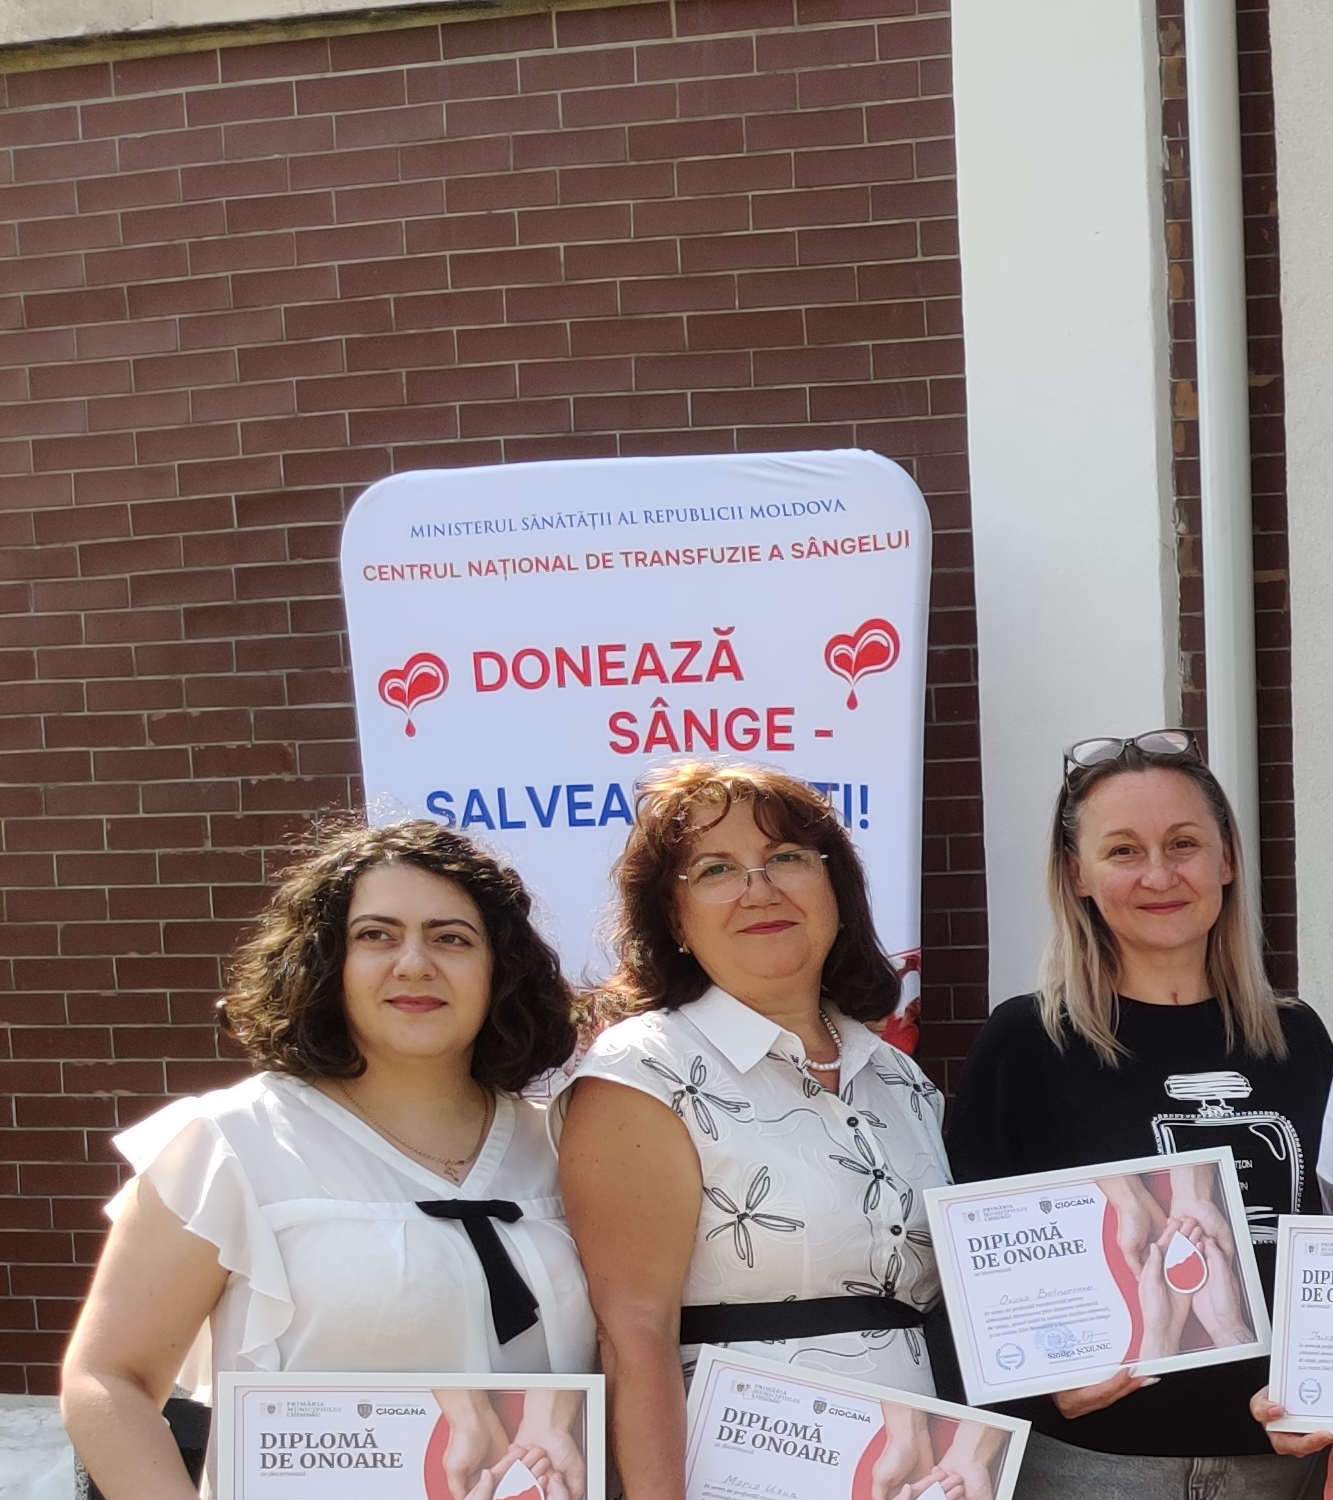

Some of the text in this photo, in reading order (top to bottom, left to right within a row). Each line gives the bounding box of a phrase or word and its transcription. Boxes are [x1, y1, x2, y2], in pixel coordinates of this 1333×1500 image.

[410, 517, 517, 539] MINISTERUL
[617, 510, 639, 526] AL
[644, 505, 744, 524] REPUBLICII
[750, 498, 847, 520] MOLDOVA
[362, 529, 910, 582] CENTRUL NAȚIONAL DE TRANSFUZIE A SÂNGELUI
[472, 626, 744, 692] DONEAZĂ
[608, 697, 795, 754] SÂNGE
[426, 783, 643, 831] SALVEA
[967, 1221, 1064, 1253] DIPLOMĂ
[971, 1239, 1087, 1270] DE ONOARE
[1301, 1287, 1323, 1302] DE
[376, 1408, 427, 1416] CIOCANA
[721, 1406, 824, 1444] DIPLOMĂ
[828, 1407, 872, 1424] CIOCANA
[259, 1428, 379, 1449] DIPLOMĂ
[716, 1424, 747, 1445] DE
[751, 1433, 841, 1467] ONOARE
[259, 1452, 403, 1469] DE ONOARE
